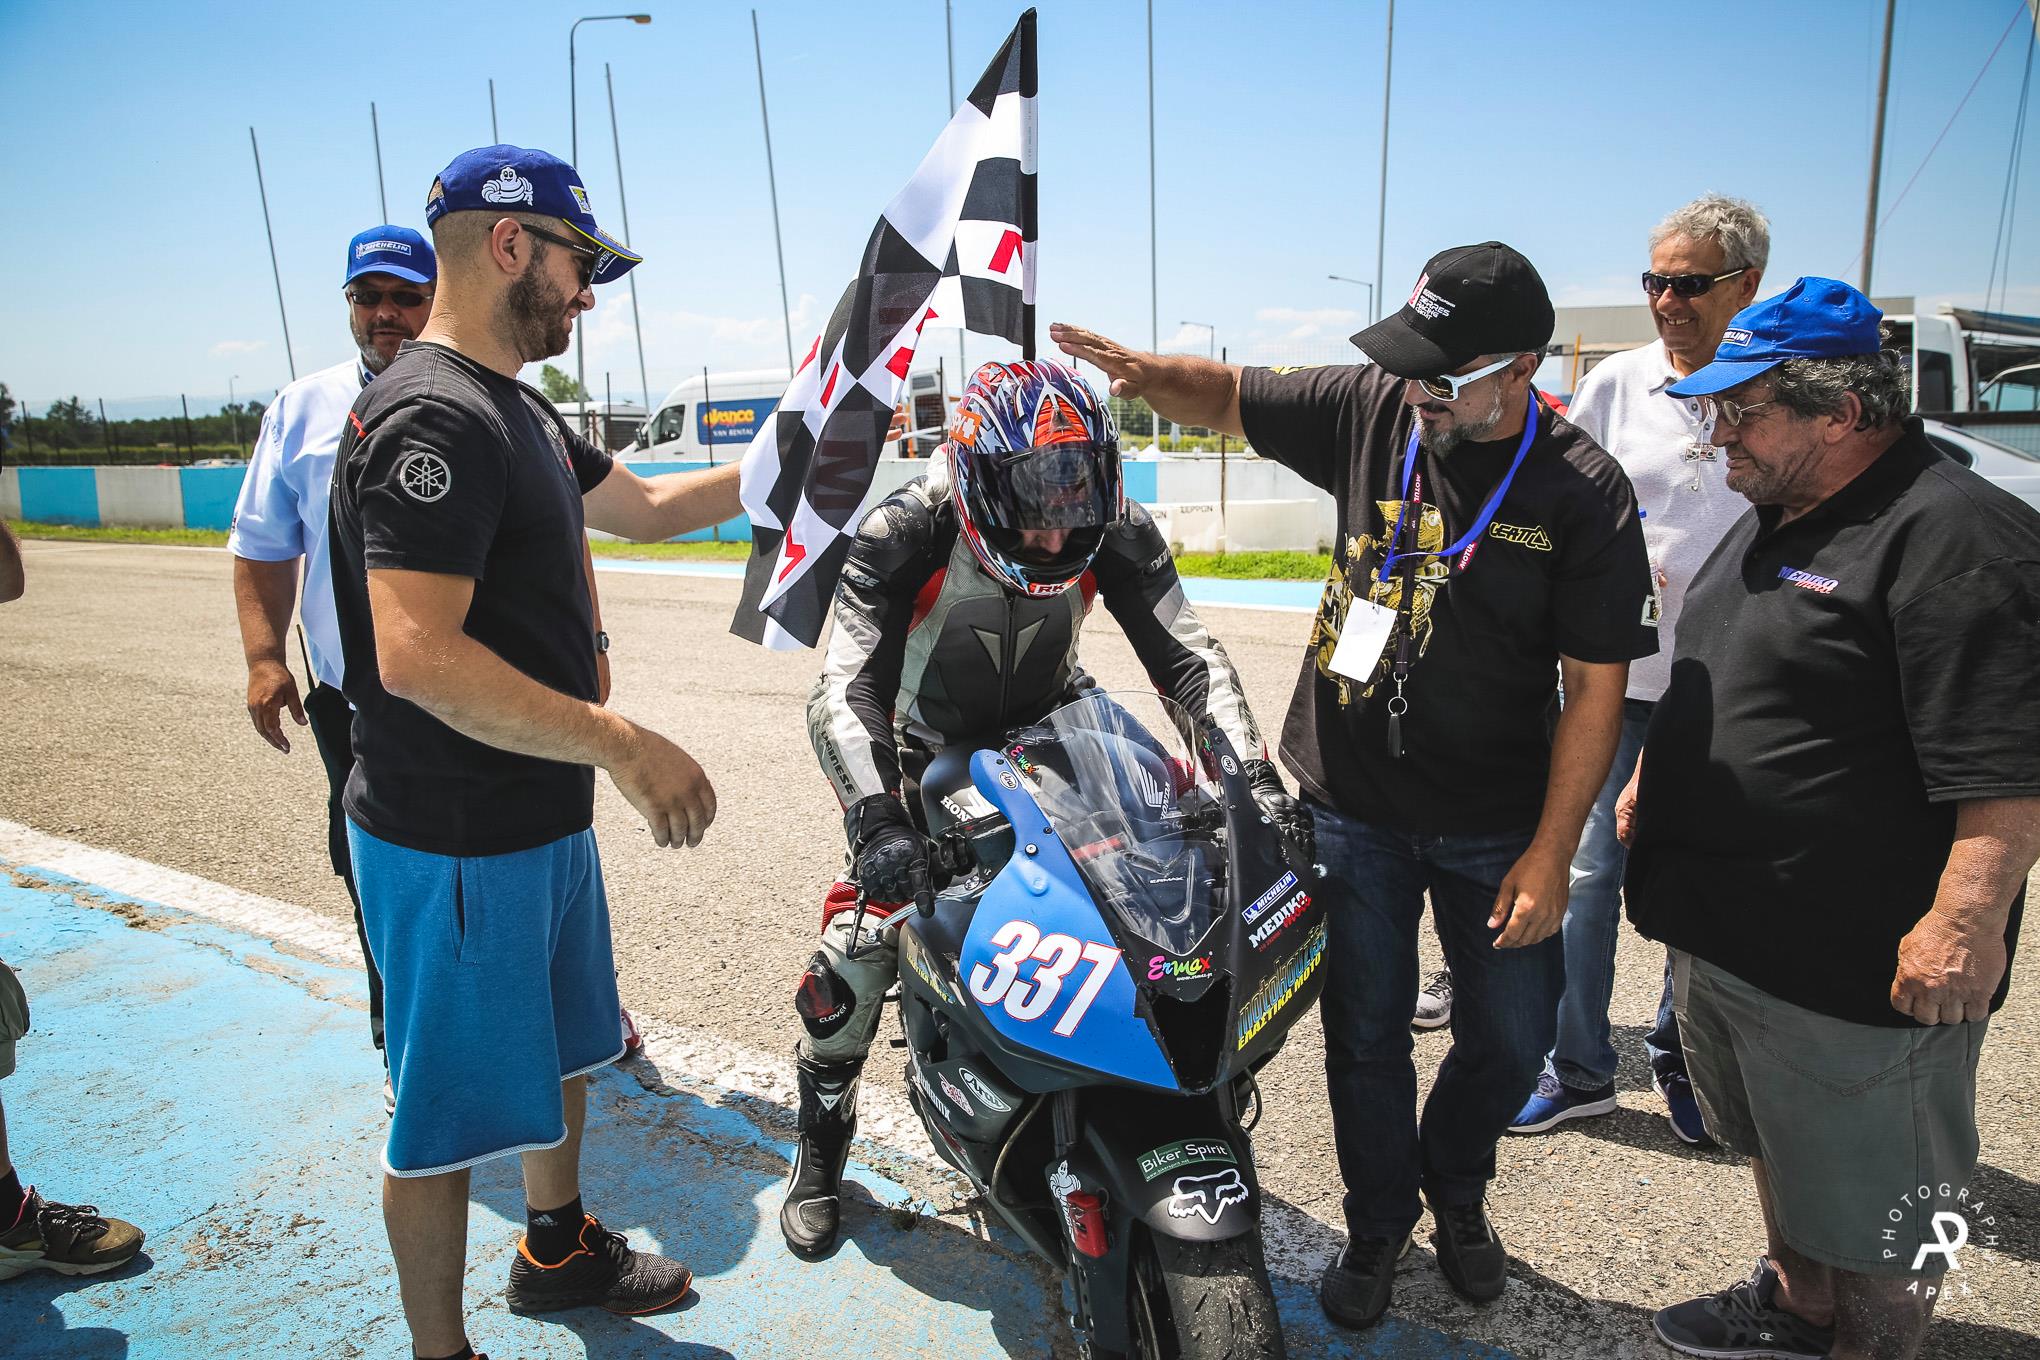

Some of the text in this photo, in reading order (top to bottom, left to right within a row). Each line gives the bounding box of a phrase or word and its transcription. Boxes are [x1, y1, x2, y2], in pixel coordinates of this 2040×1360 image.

[1419, 295, 1450, 317] SERRES
[713, 429, 727, 438] VAN
[1413, 473, 1421, 502] MOTUL
[1459, 543, 1475, 570] MOTUL
[1777, 566, 1839, 590] MEDIKO
[940, 795, 973, 822] HON
[1256, 873, 1293, 910] MICHELIN
[1248, 890, 1307, 949] MEDIKO
[969, 919, 1123, 1039] 337
[1147, 953, 1212, 981] Ermax
[1141, 1149, 1182, 1173] Biker
[1185, 1143, 1228, 1161] Spirit
